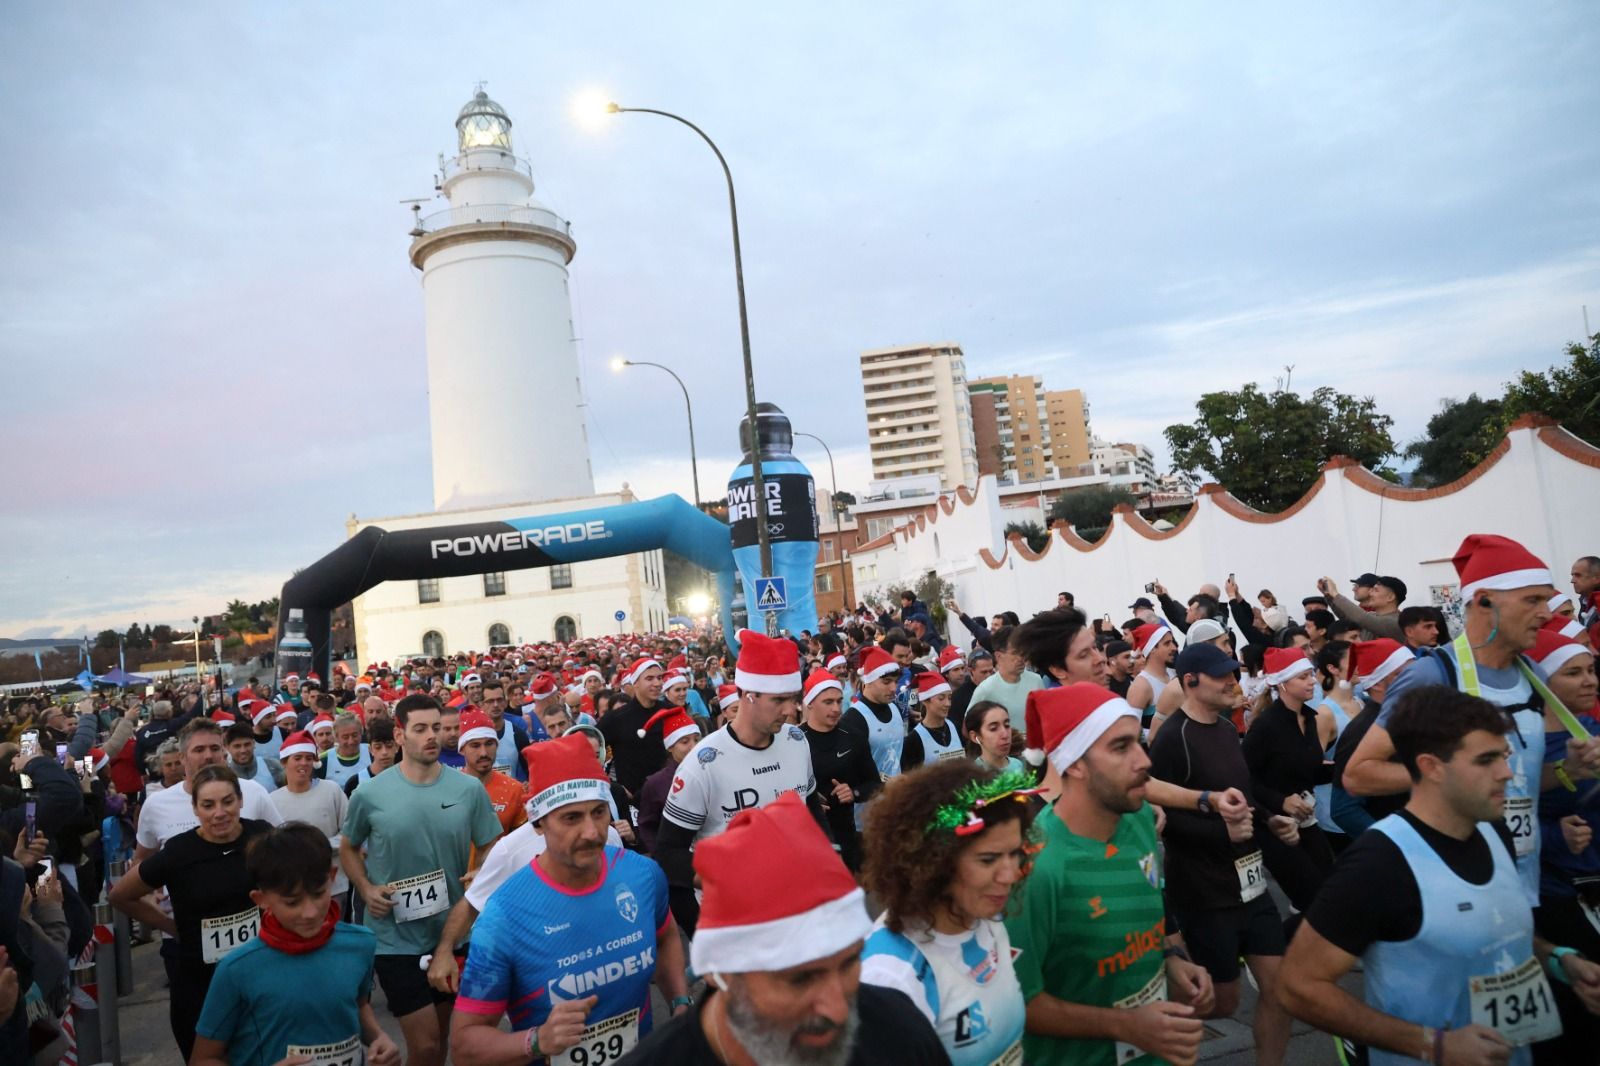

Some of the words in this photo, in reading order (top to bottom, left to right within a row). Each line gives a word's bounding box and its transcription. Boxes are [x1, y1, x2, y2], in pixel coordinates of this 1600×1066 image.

[431, 520, 606, 559] POWERADE
[567, 780, 597, 790] NAVIDAD
[401, 885, 438, 908] 714
[210, 920, 257, 949] 1161
[595, 945, 603, 956] A
[606, 930, 643, 951] CORRER
[1484, 982, 1550, 1028] 1341
[570, 1034, 623, 1066] 939
